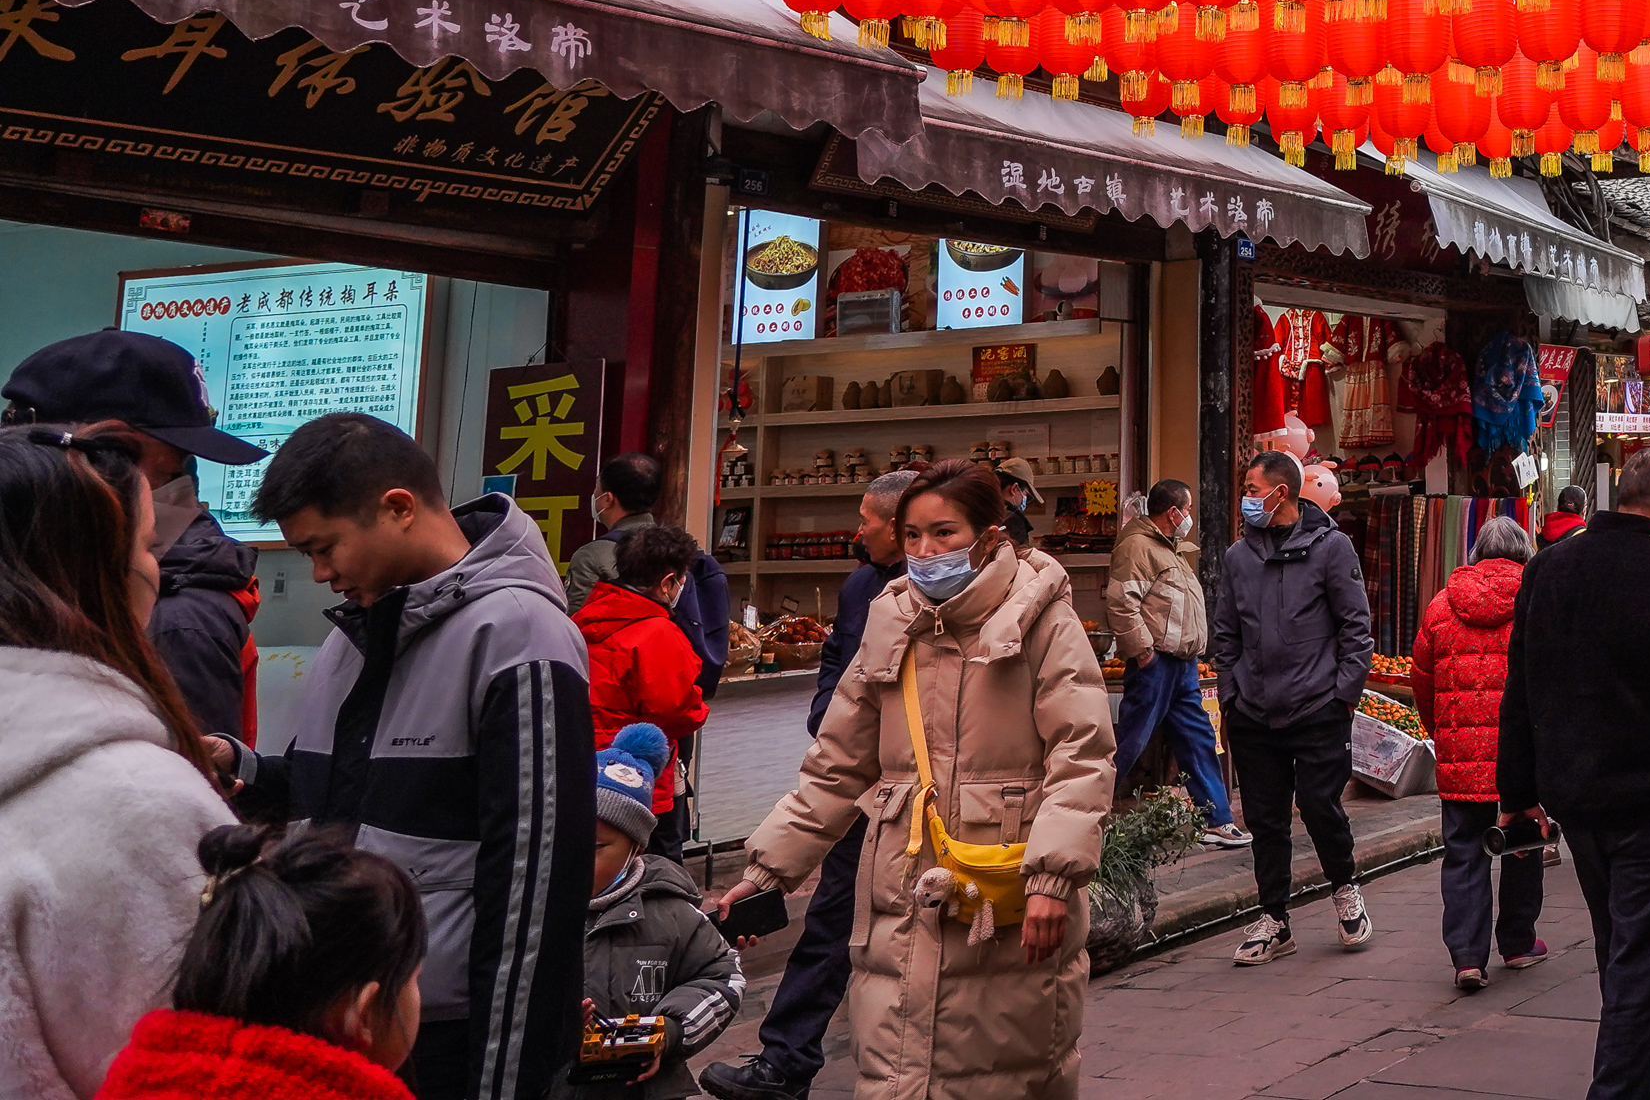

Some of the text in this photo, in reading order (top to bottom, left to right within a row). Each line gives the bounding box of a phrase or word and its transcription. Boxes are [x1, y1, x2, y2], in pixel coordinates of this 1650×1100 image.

[744, 179, 763, 192] 256
[140, 296, 232, 321] 非物质文化遗产
